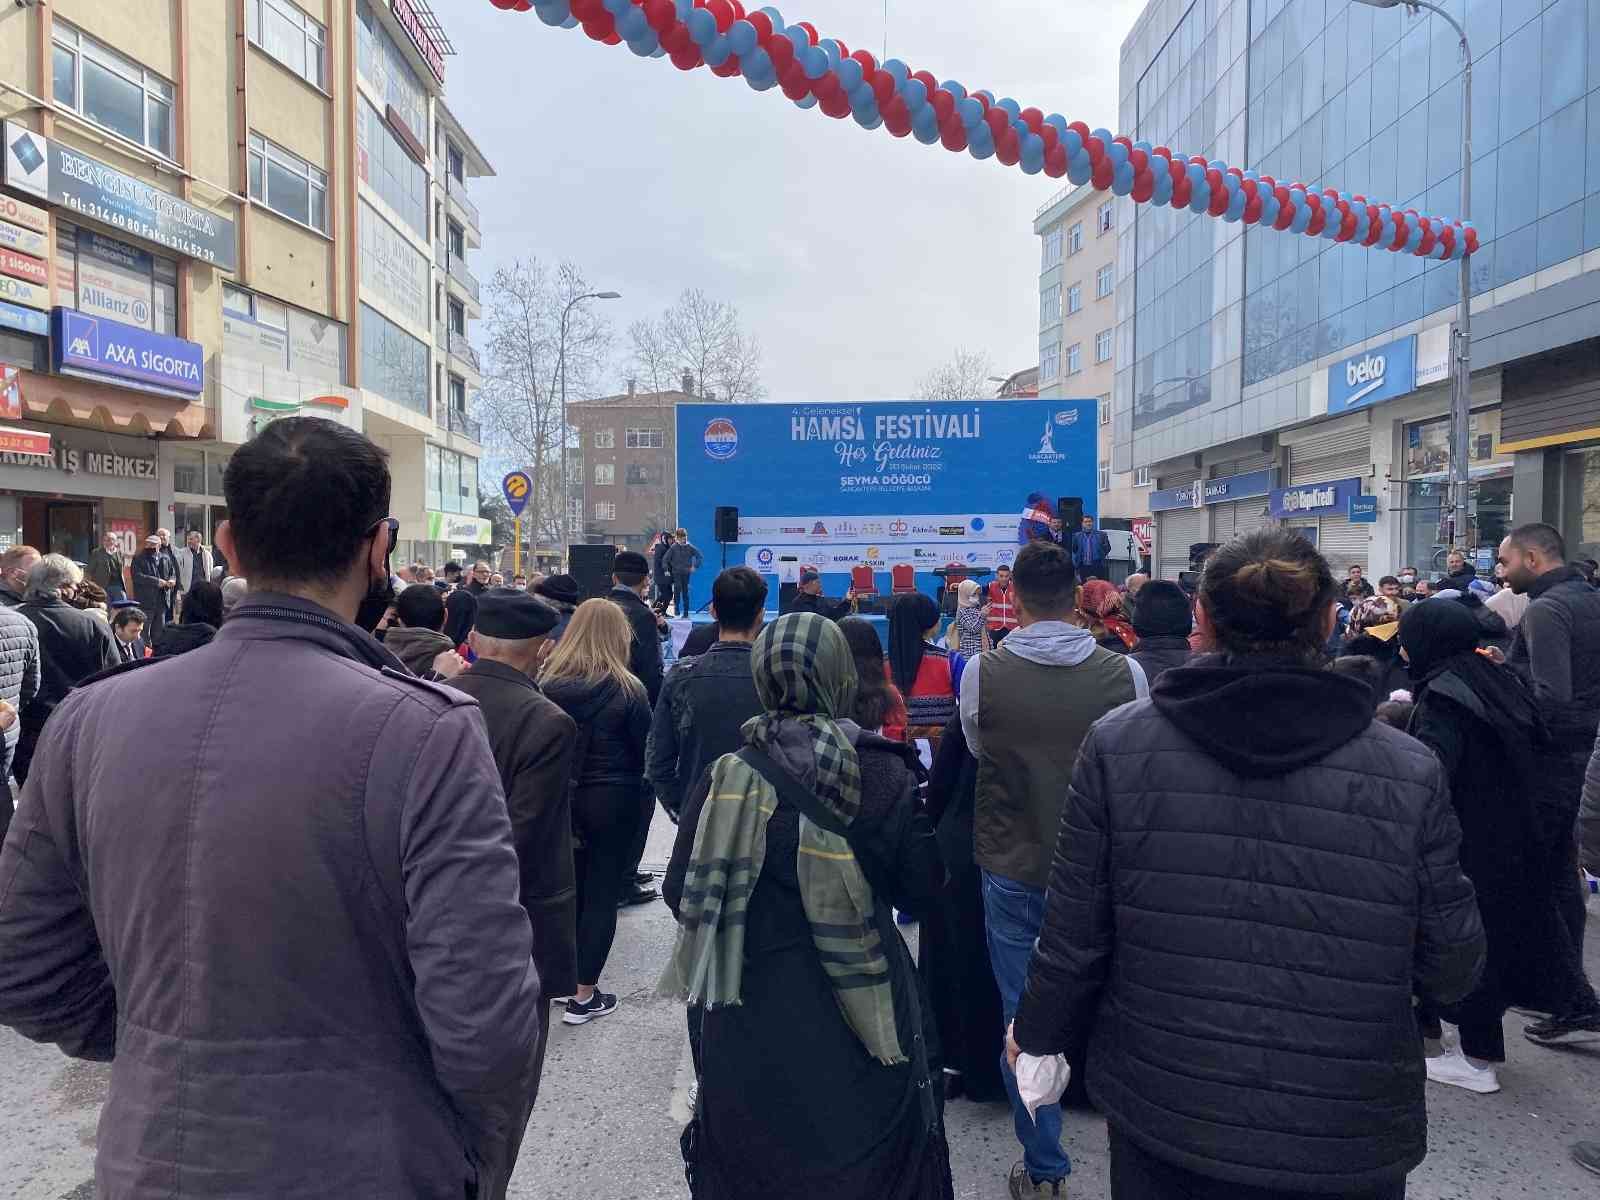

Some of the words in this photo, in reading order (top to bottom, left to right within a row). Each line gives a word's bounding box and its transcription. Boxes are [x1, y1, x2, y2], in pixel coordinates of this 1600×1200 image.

[62, 191, 86, 212] Tel:
[88, 203, 110, 222] 314
[112, 214, 125, 227] 60
[127, 217, 140, 233] 80
[172, 236, 189, 252] 314
[191, 242, 204, 258] 52
[81, 287, 129, 316] Allianz
[68, 336, 91, 357] AXA
[105, 344, 137, 367] AXA
[142, 349, 200, 382] SİGORTA
[1345, 354, 1386, 387] beko
[875, 407, 980, 440] FESTİVALİ
[873, 440, 942, 473] Geldiniz
[840, 476, 880, 487] ŞEYMA
